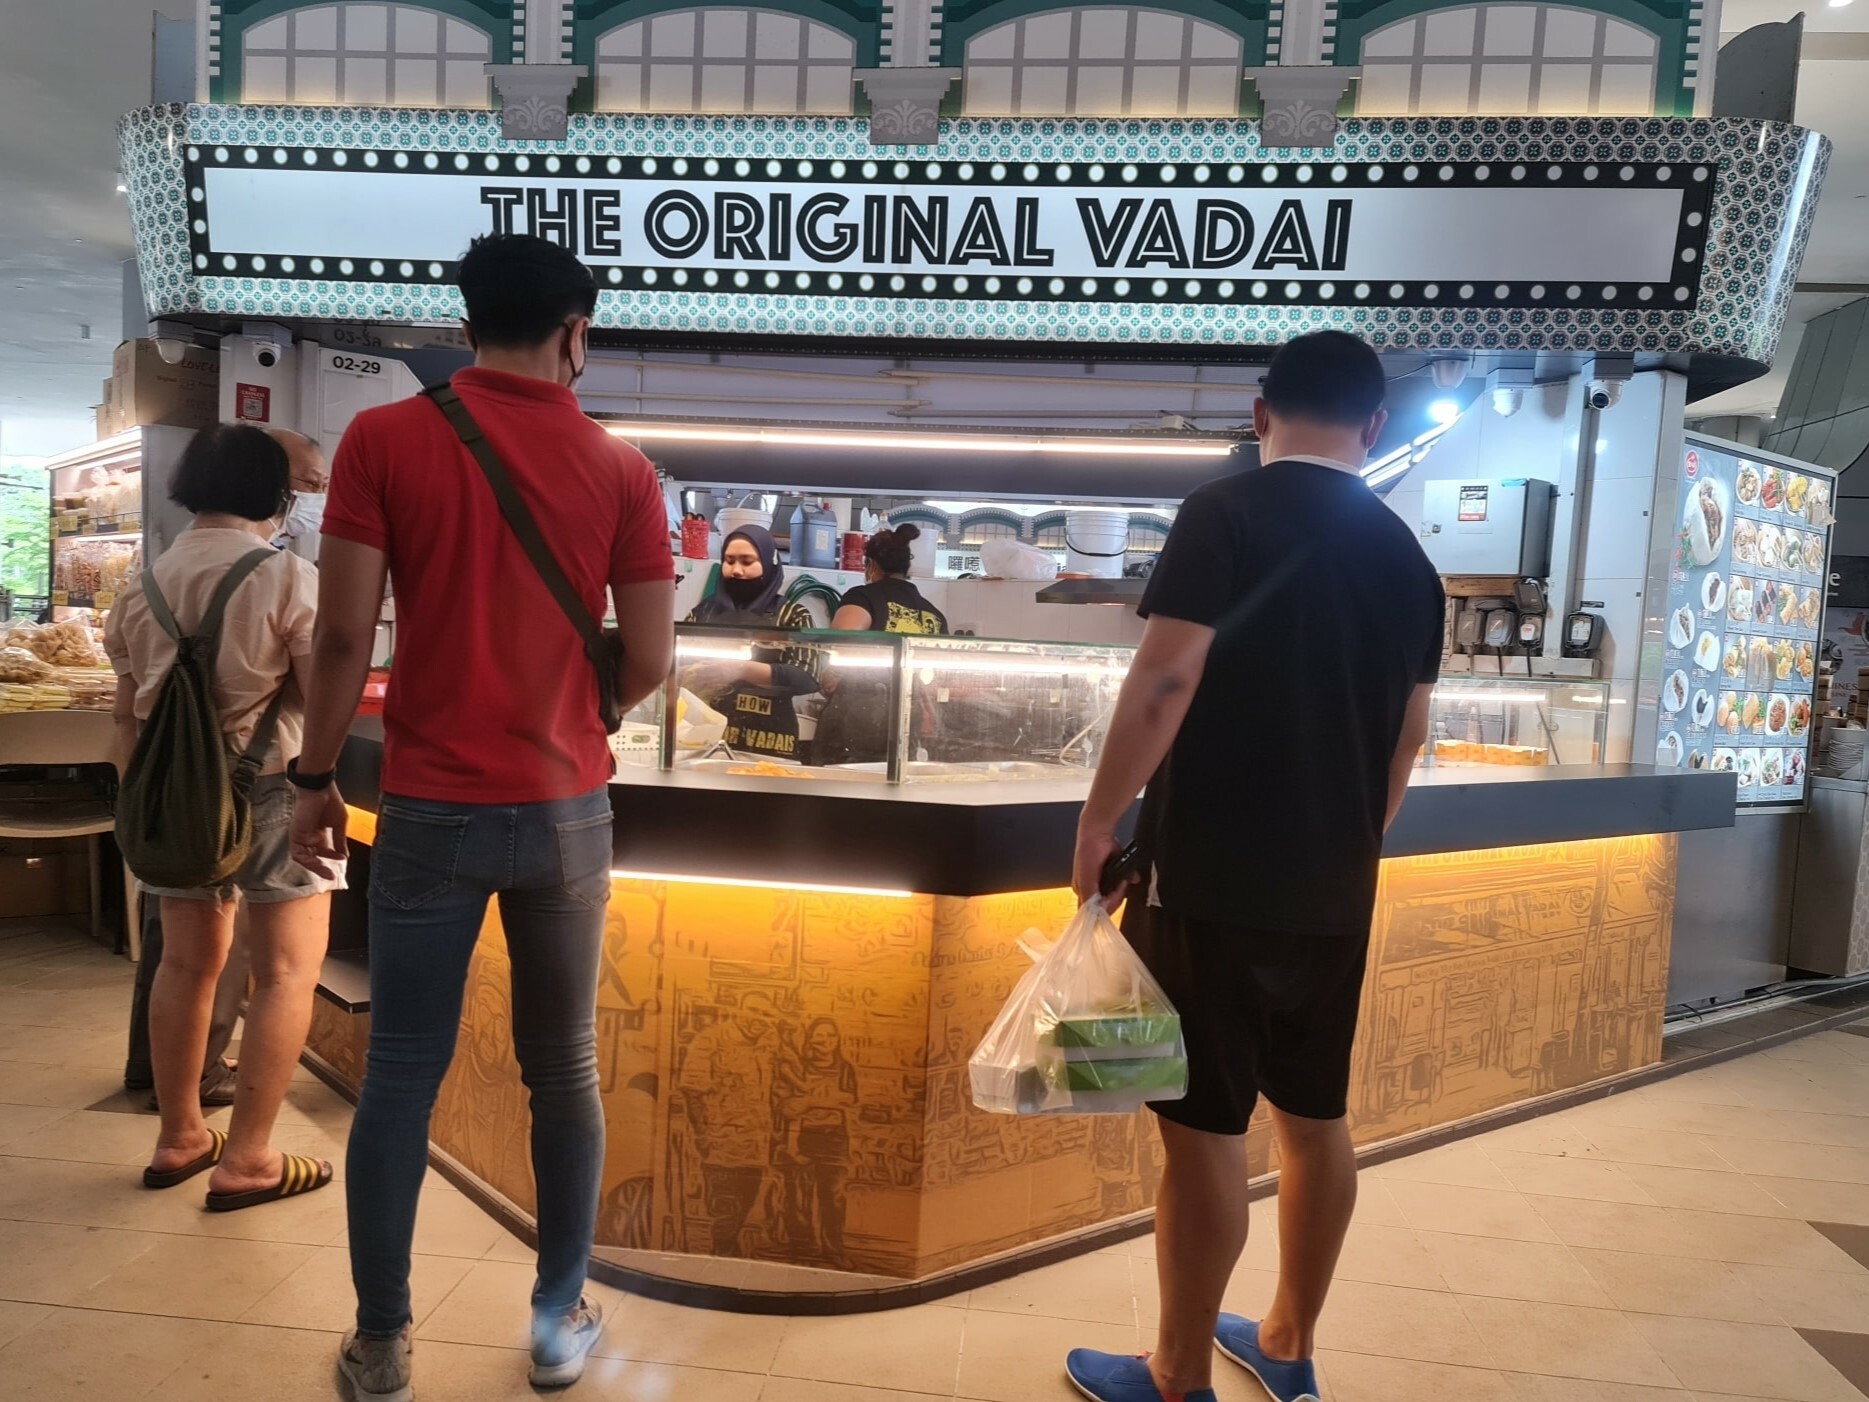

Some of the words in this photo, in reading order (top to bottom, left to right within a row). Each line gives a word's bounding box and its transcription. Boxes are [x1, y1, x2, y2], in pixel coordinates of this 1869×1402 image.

[481, 186, 622, 257] THE
[643, 188, 1055, 267] ORIGINAL
[1075, 197, 1353, 271] VADAI
[332, 355, 381, 374] 02-29
[738, 695, 770, 713] HOW
[746, 728, 795, 752] VADAIS
